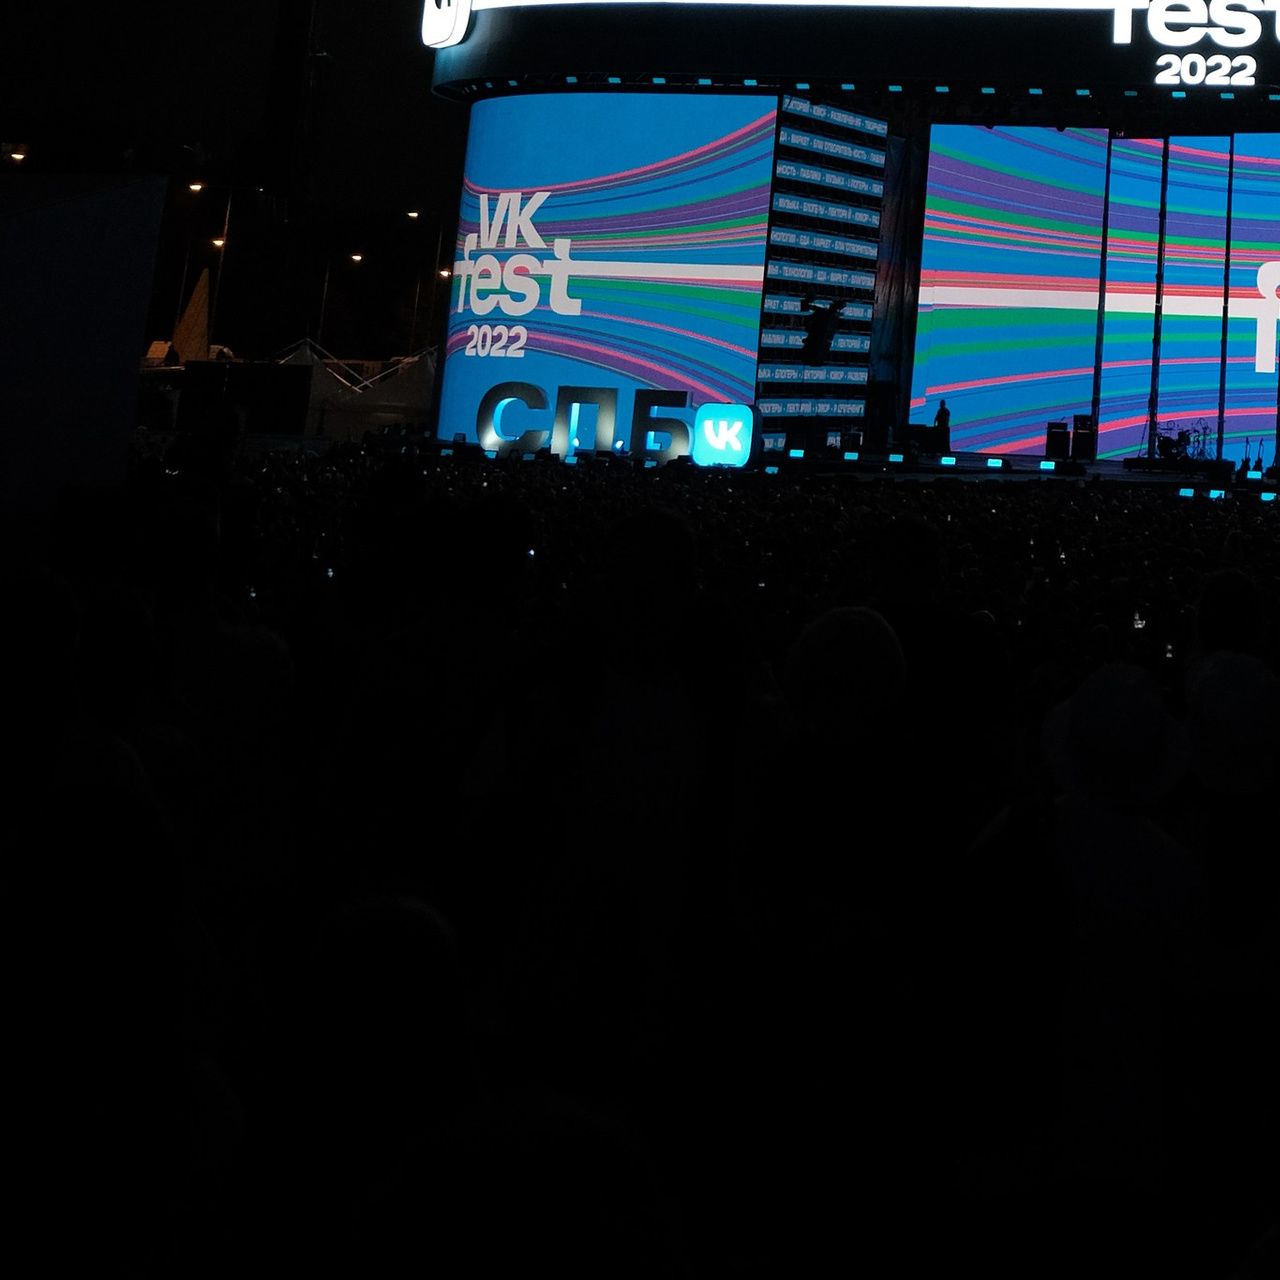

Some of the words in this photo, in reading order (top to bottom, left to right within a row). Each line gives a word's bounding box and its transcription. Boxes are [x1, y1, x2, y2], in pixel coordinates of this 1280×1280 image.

[1154, 53, 1258, 86] 2022
[480, 192, 552, 249] VK
[457, 233, 582, 316] fest
[465, 324, 528, 358] 2022
[476, 381, 694, 462] СПБ
[703, 419, 743, 451] VK
